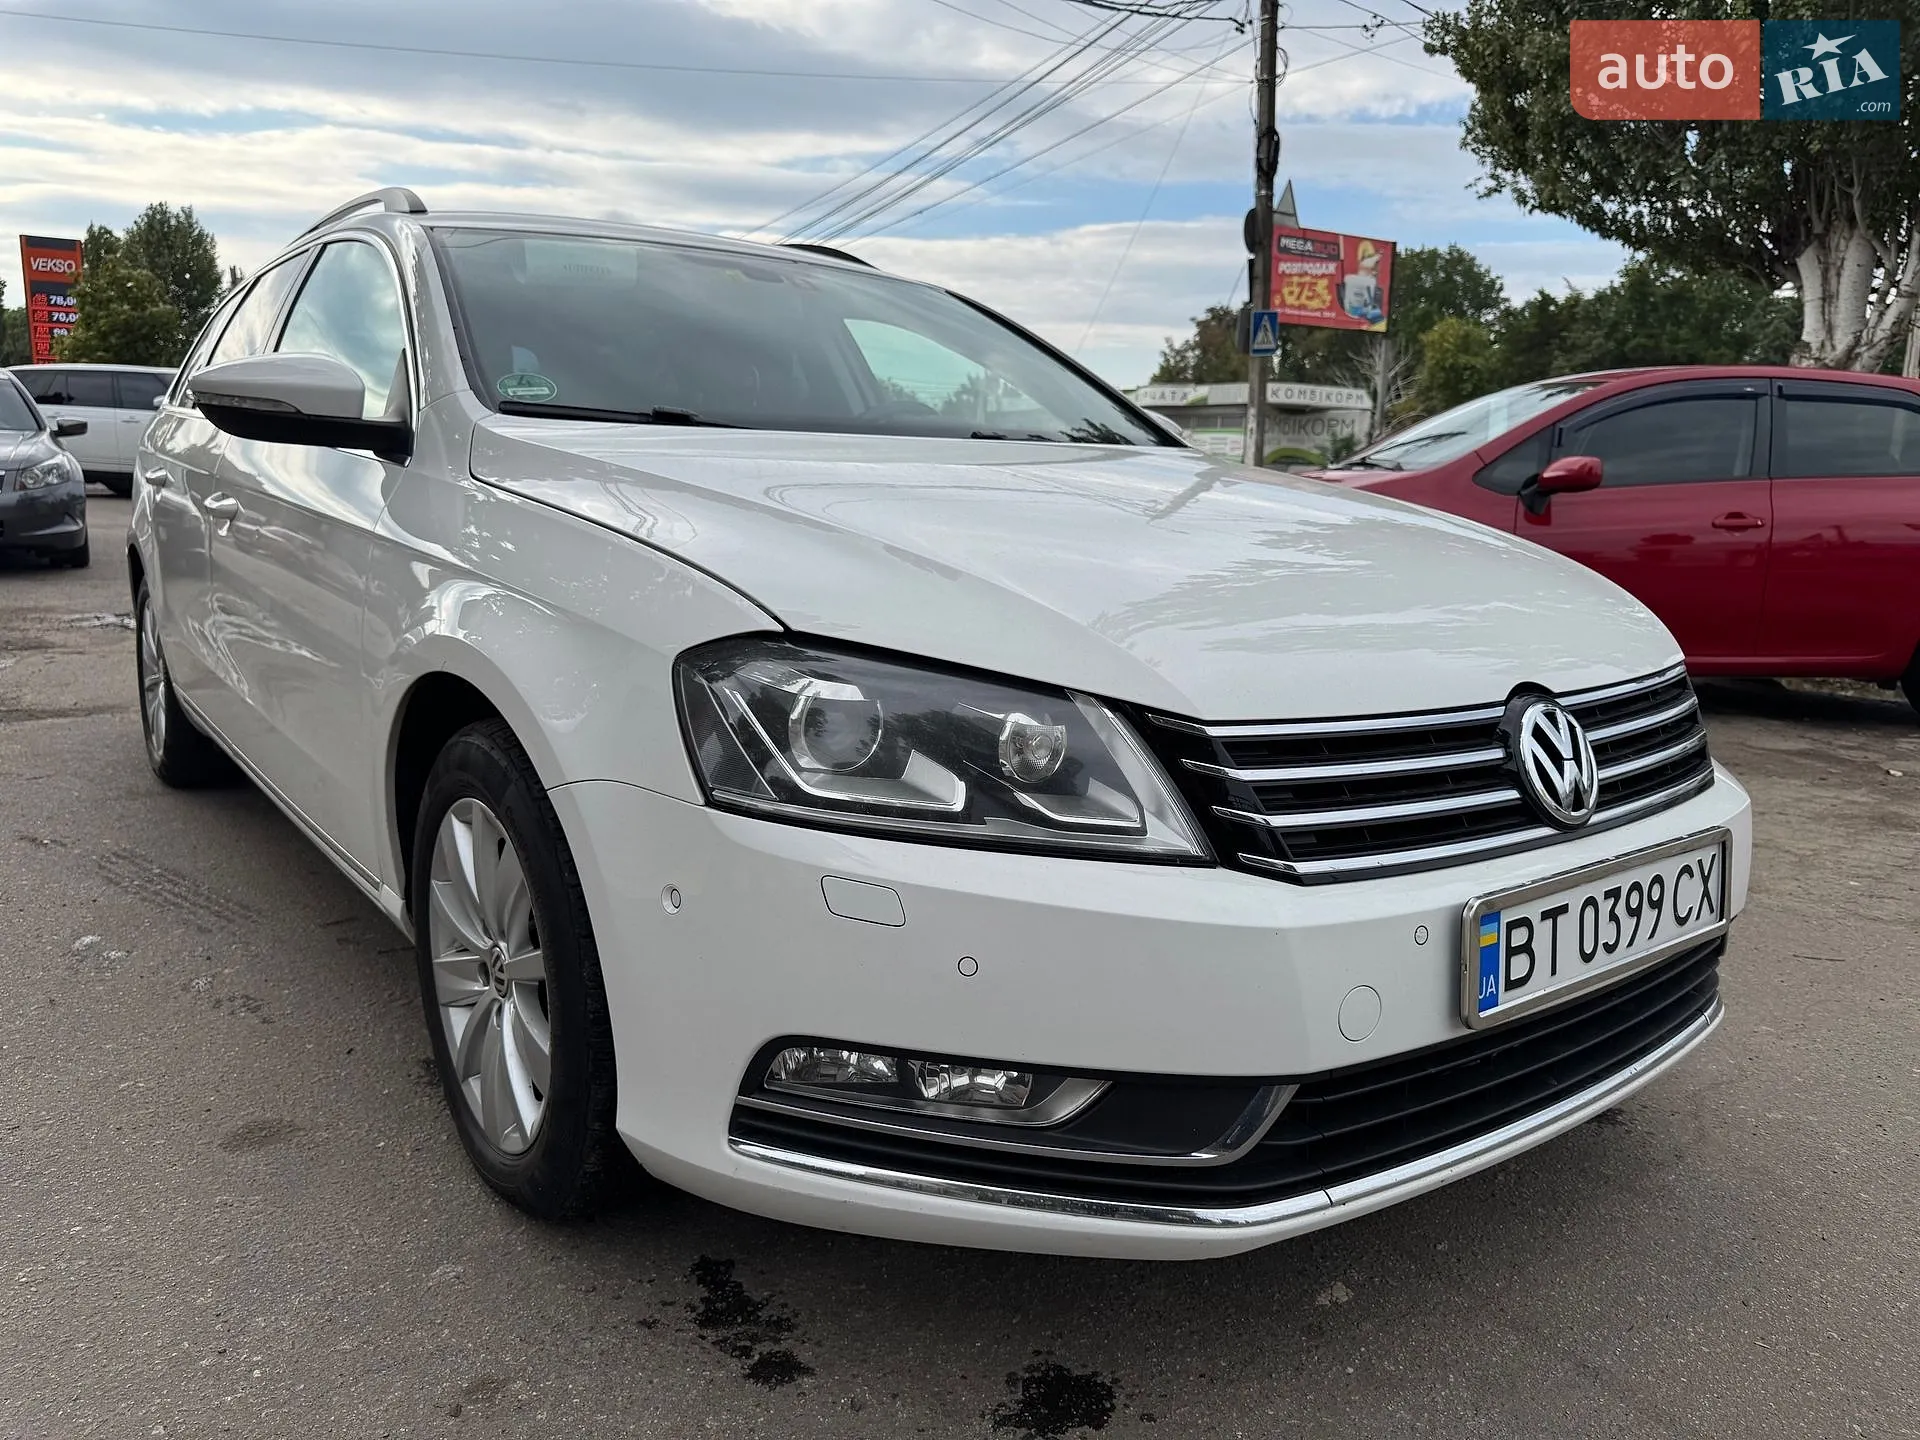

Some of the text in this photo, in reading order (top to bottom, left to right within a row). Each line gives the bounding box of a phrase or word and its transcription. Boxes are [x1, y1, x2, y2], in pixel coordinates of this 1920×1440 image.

[30, 256, 76, 273] VEKSO
[1270, 386, 1364, 405] КОМБІКОРМ
[1504, 852, 1717, 993] BT 0399 CX
